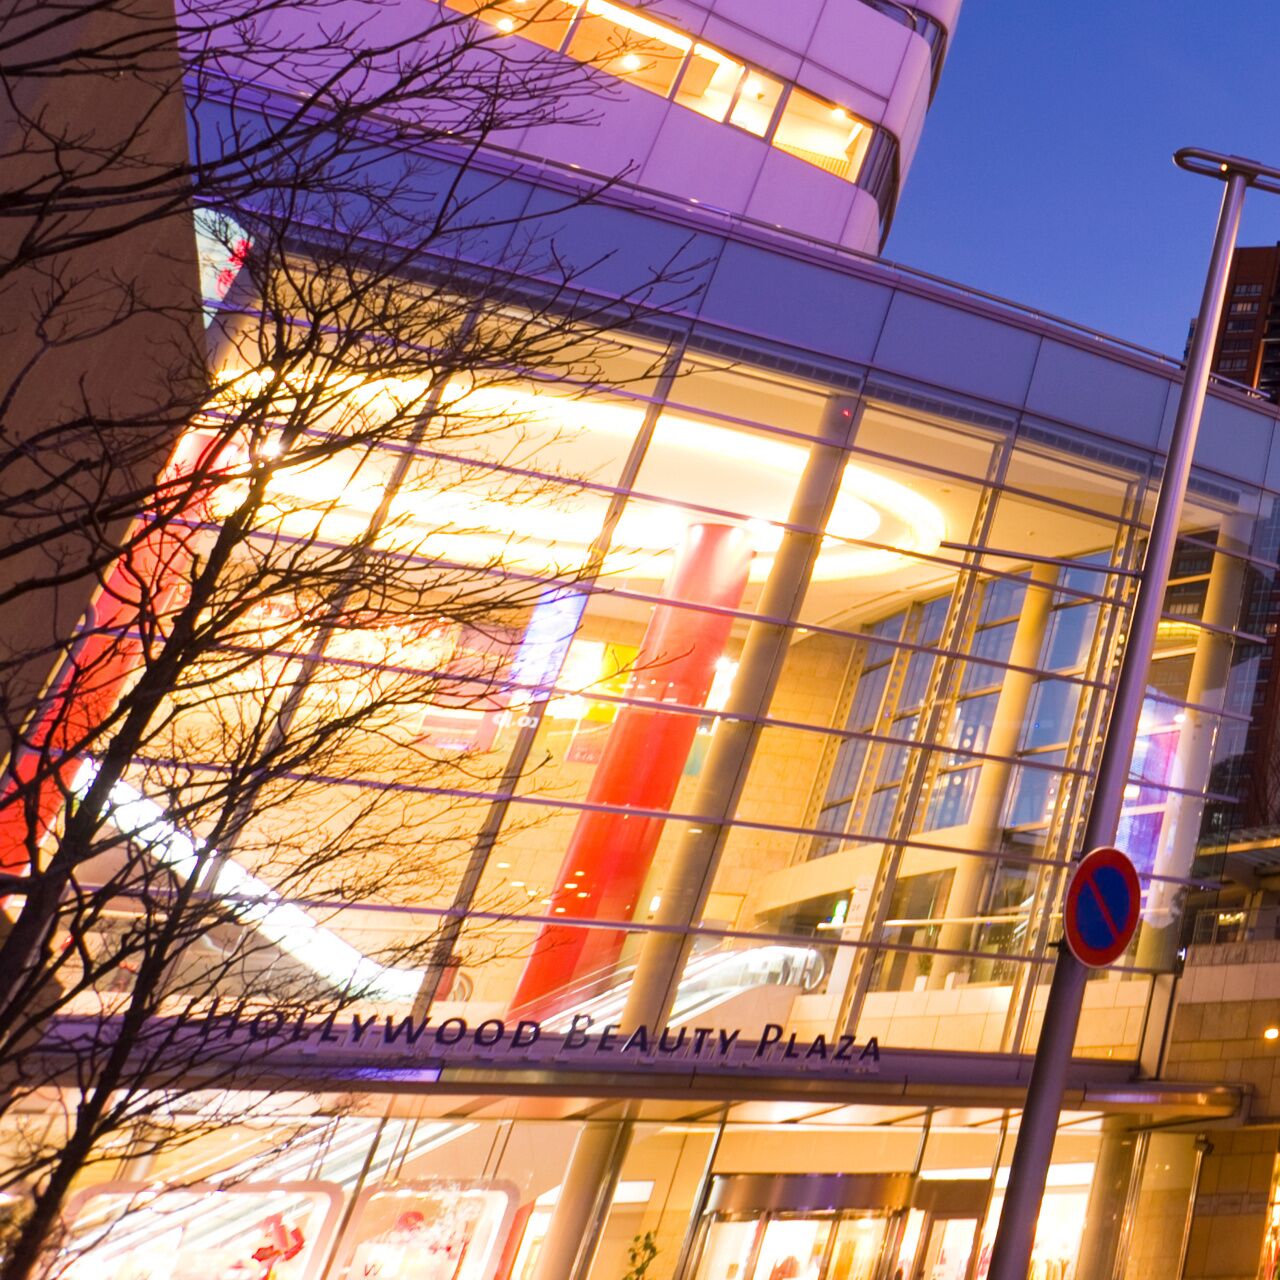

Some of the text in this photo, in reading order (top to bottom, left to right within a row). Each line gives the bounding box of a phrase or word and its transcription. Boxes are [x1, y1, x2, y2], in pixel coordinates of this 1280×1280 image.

[199, 996, 881, 1061] HOLLYWOOD BEAUTY PLAZA
